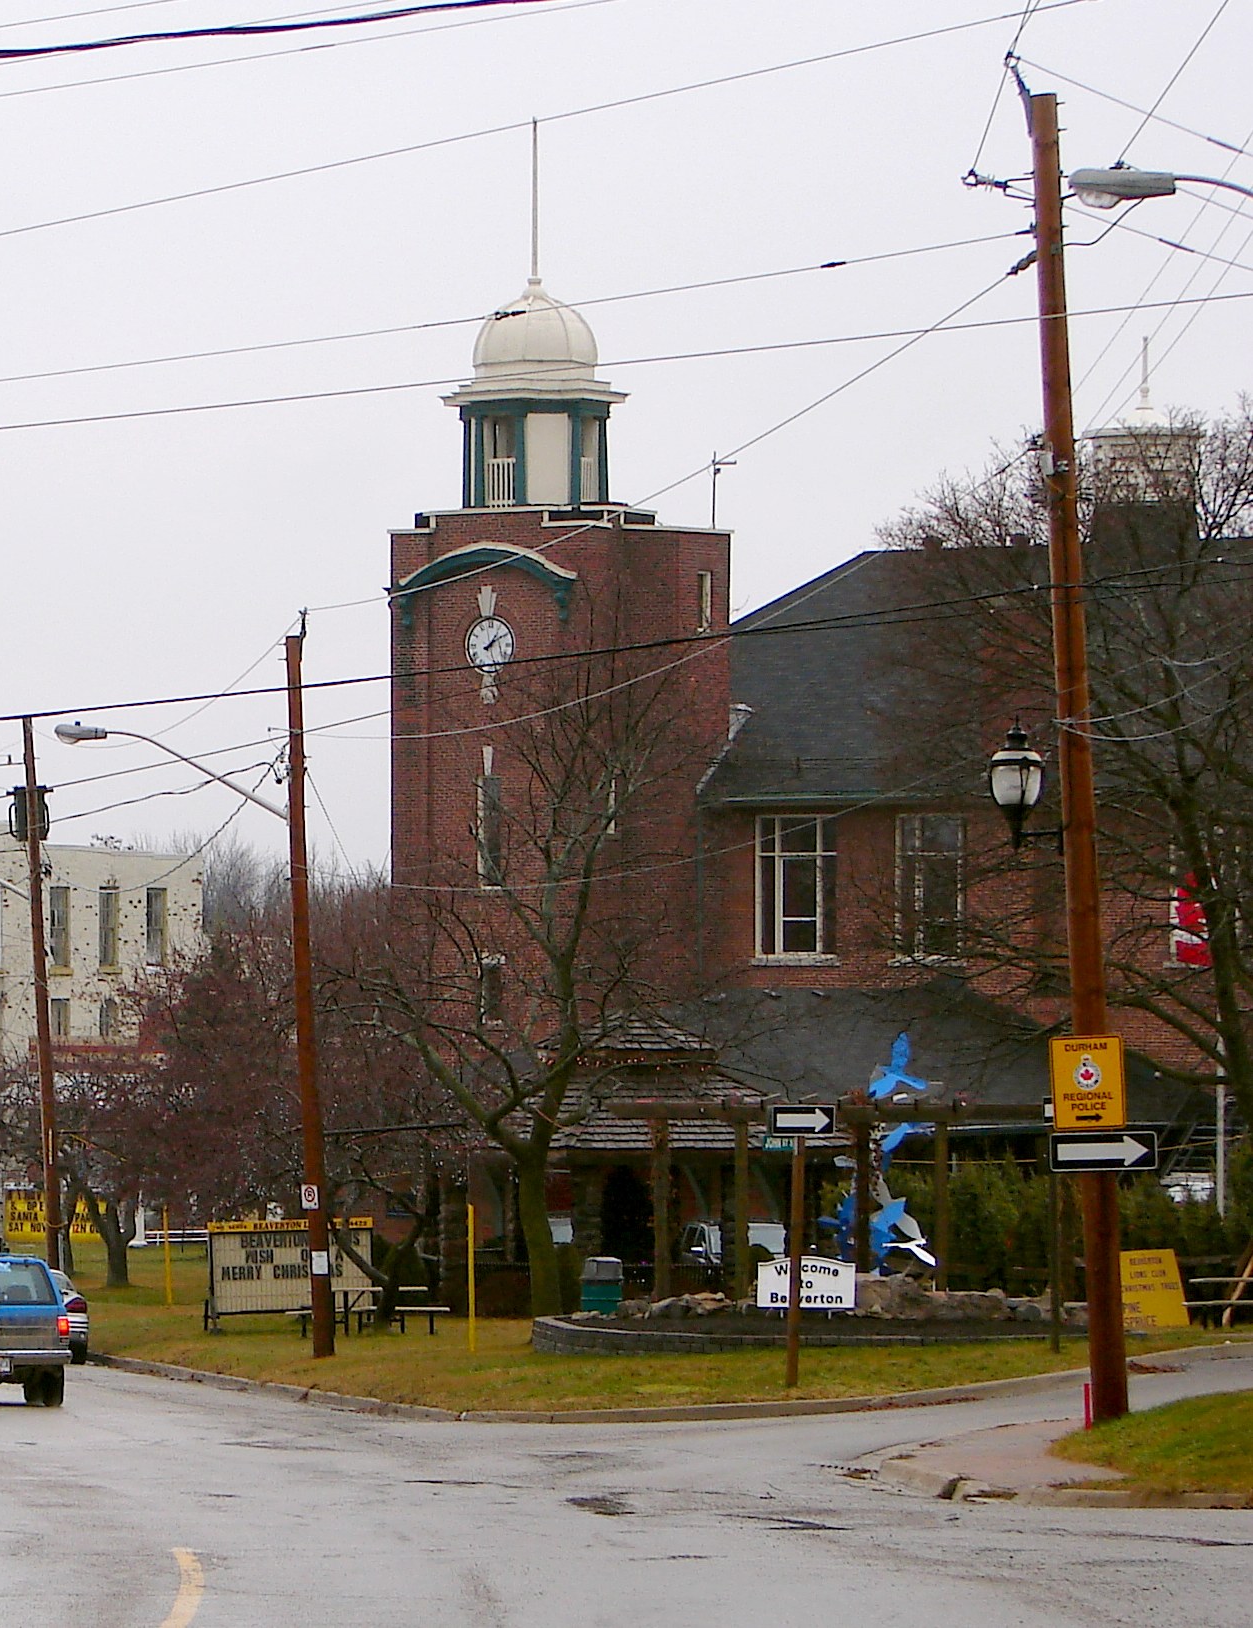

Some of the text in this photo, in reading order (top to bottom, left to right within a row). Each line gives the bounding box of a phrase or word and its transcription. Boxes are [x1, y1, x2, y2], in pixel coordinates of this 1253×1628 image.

[1064, 1042, 1108, 1052] DURHAM
[1063, 1092, 1114, 1101] REGIONAL
[1071, 1102, 1107, 1111] POLICE
[10, 1212, 38, 1221] SANTA
[8, 1222, 24, 1232] SAT
[253, 1221, 301, 1231] BEAVERTON
[241, 1234, 308, 1249] BEAVERTON
[221, 1264, 343, 1281] MERRY CHRISAS
[774, 1263, 839, 1277] Wcome
[800, 1278, 813, 1289] to
